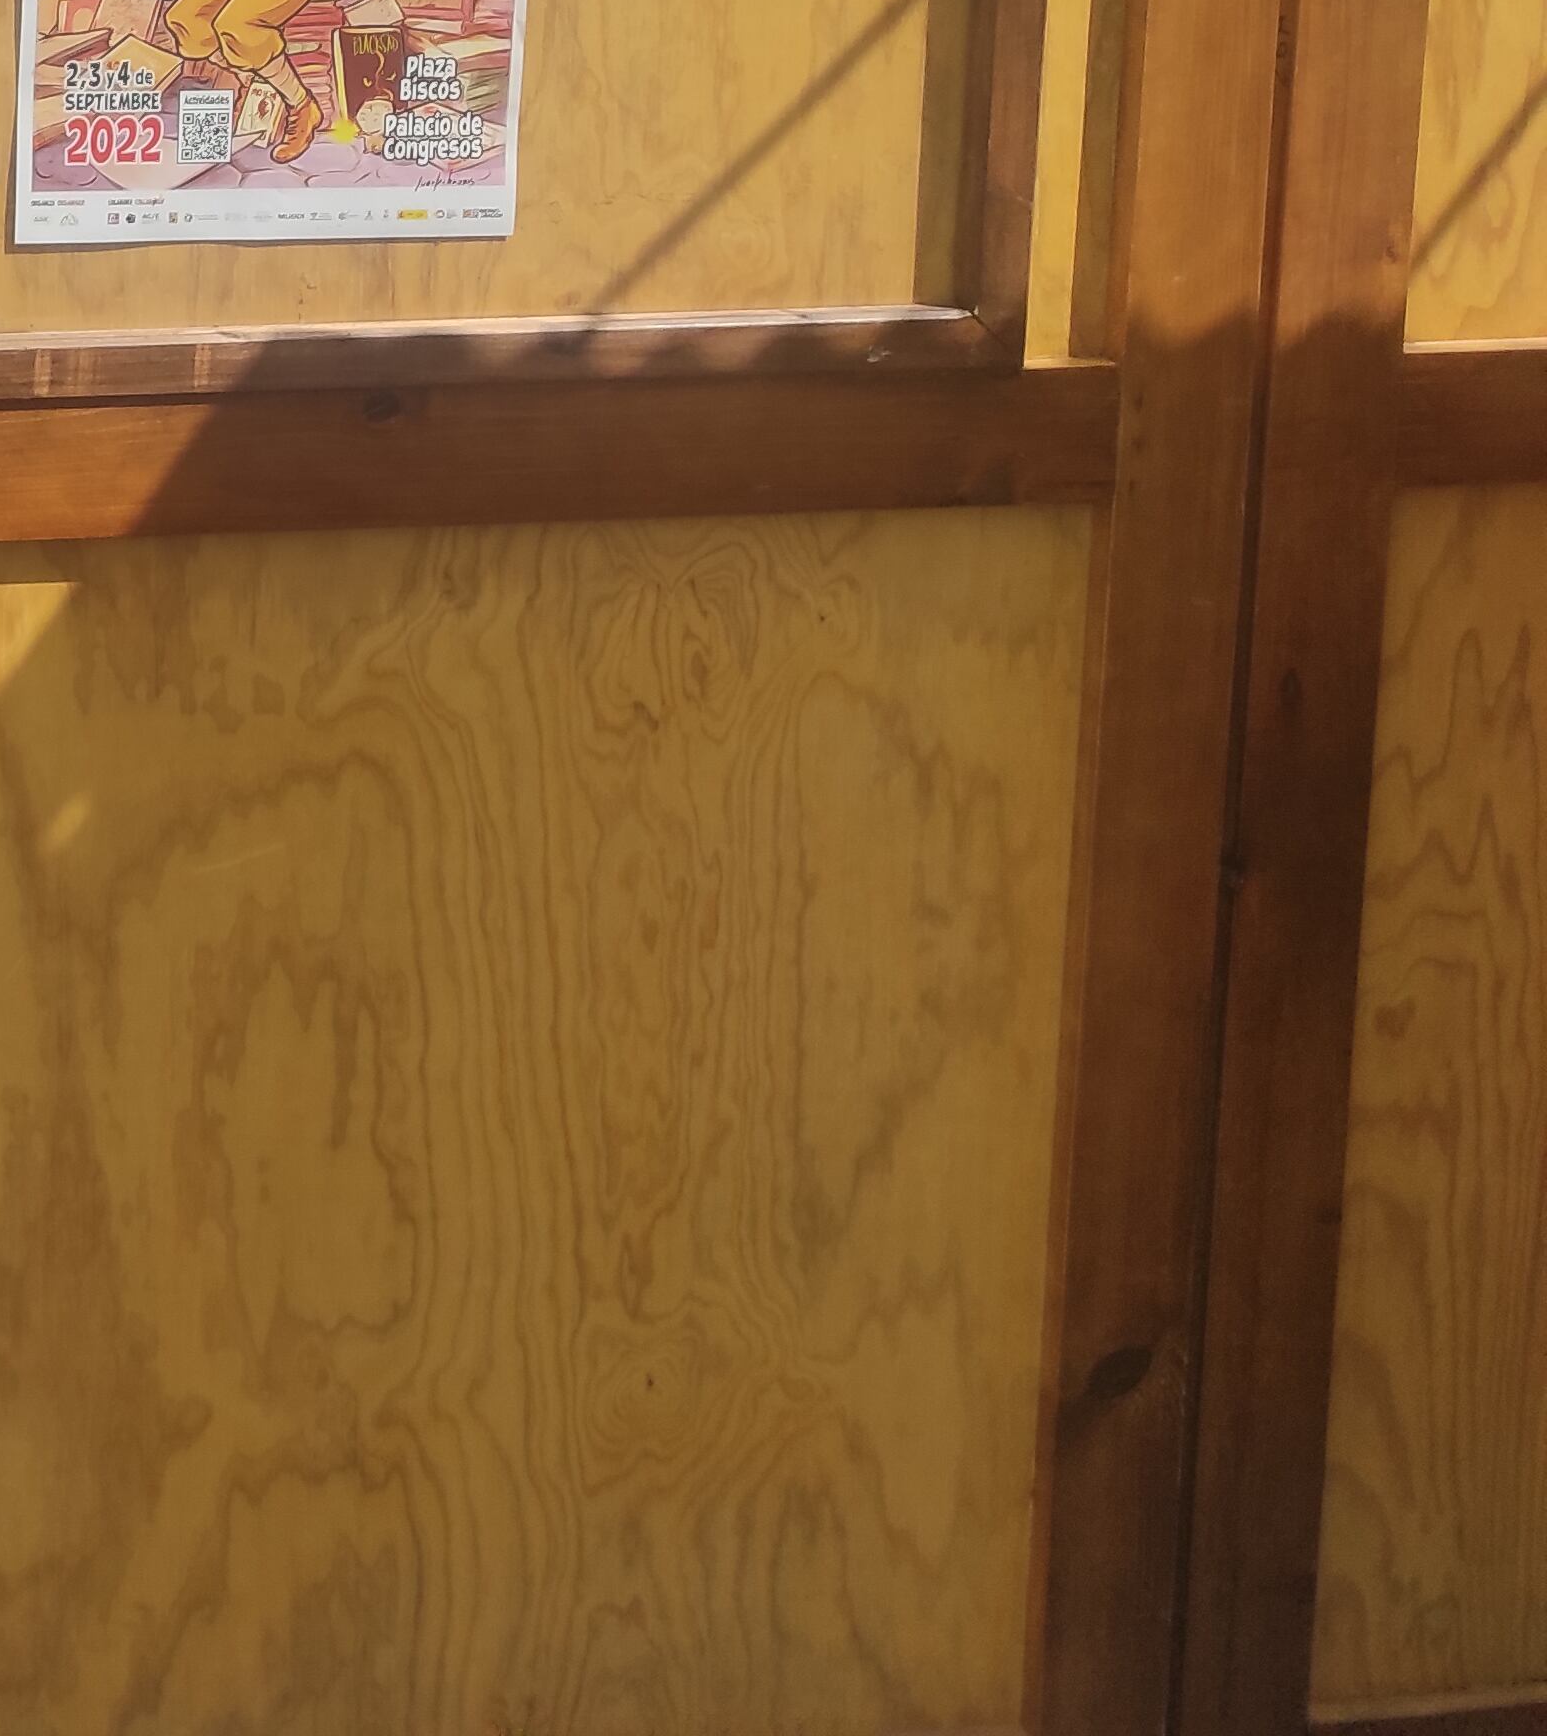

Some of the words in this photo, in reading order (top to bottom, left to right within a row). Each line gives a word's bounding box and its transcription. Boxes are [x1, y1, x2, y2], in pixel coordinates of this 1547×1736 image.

[107, 72, 115, 90] y
[117, 61, 131, 86] 4
[135, 68, 153, 85] de
[406, 53, 457, 78] Plaza
[184, 94, 230, 104] Actividades
[400, 75, 462, 101] Biscós
[65, 93, 160, 110] SEPTIEMBRE
[384, 111, 453, 137] Palacio
[459, 111, 484, 137] de
[66, 116, 162, 164] 2022
[383, 137, 484, 165] Congresos
